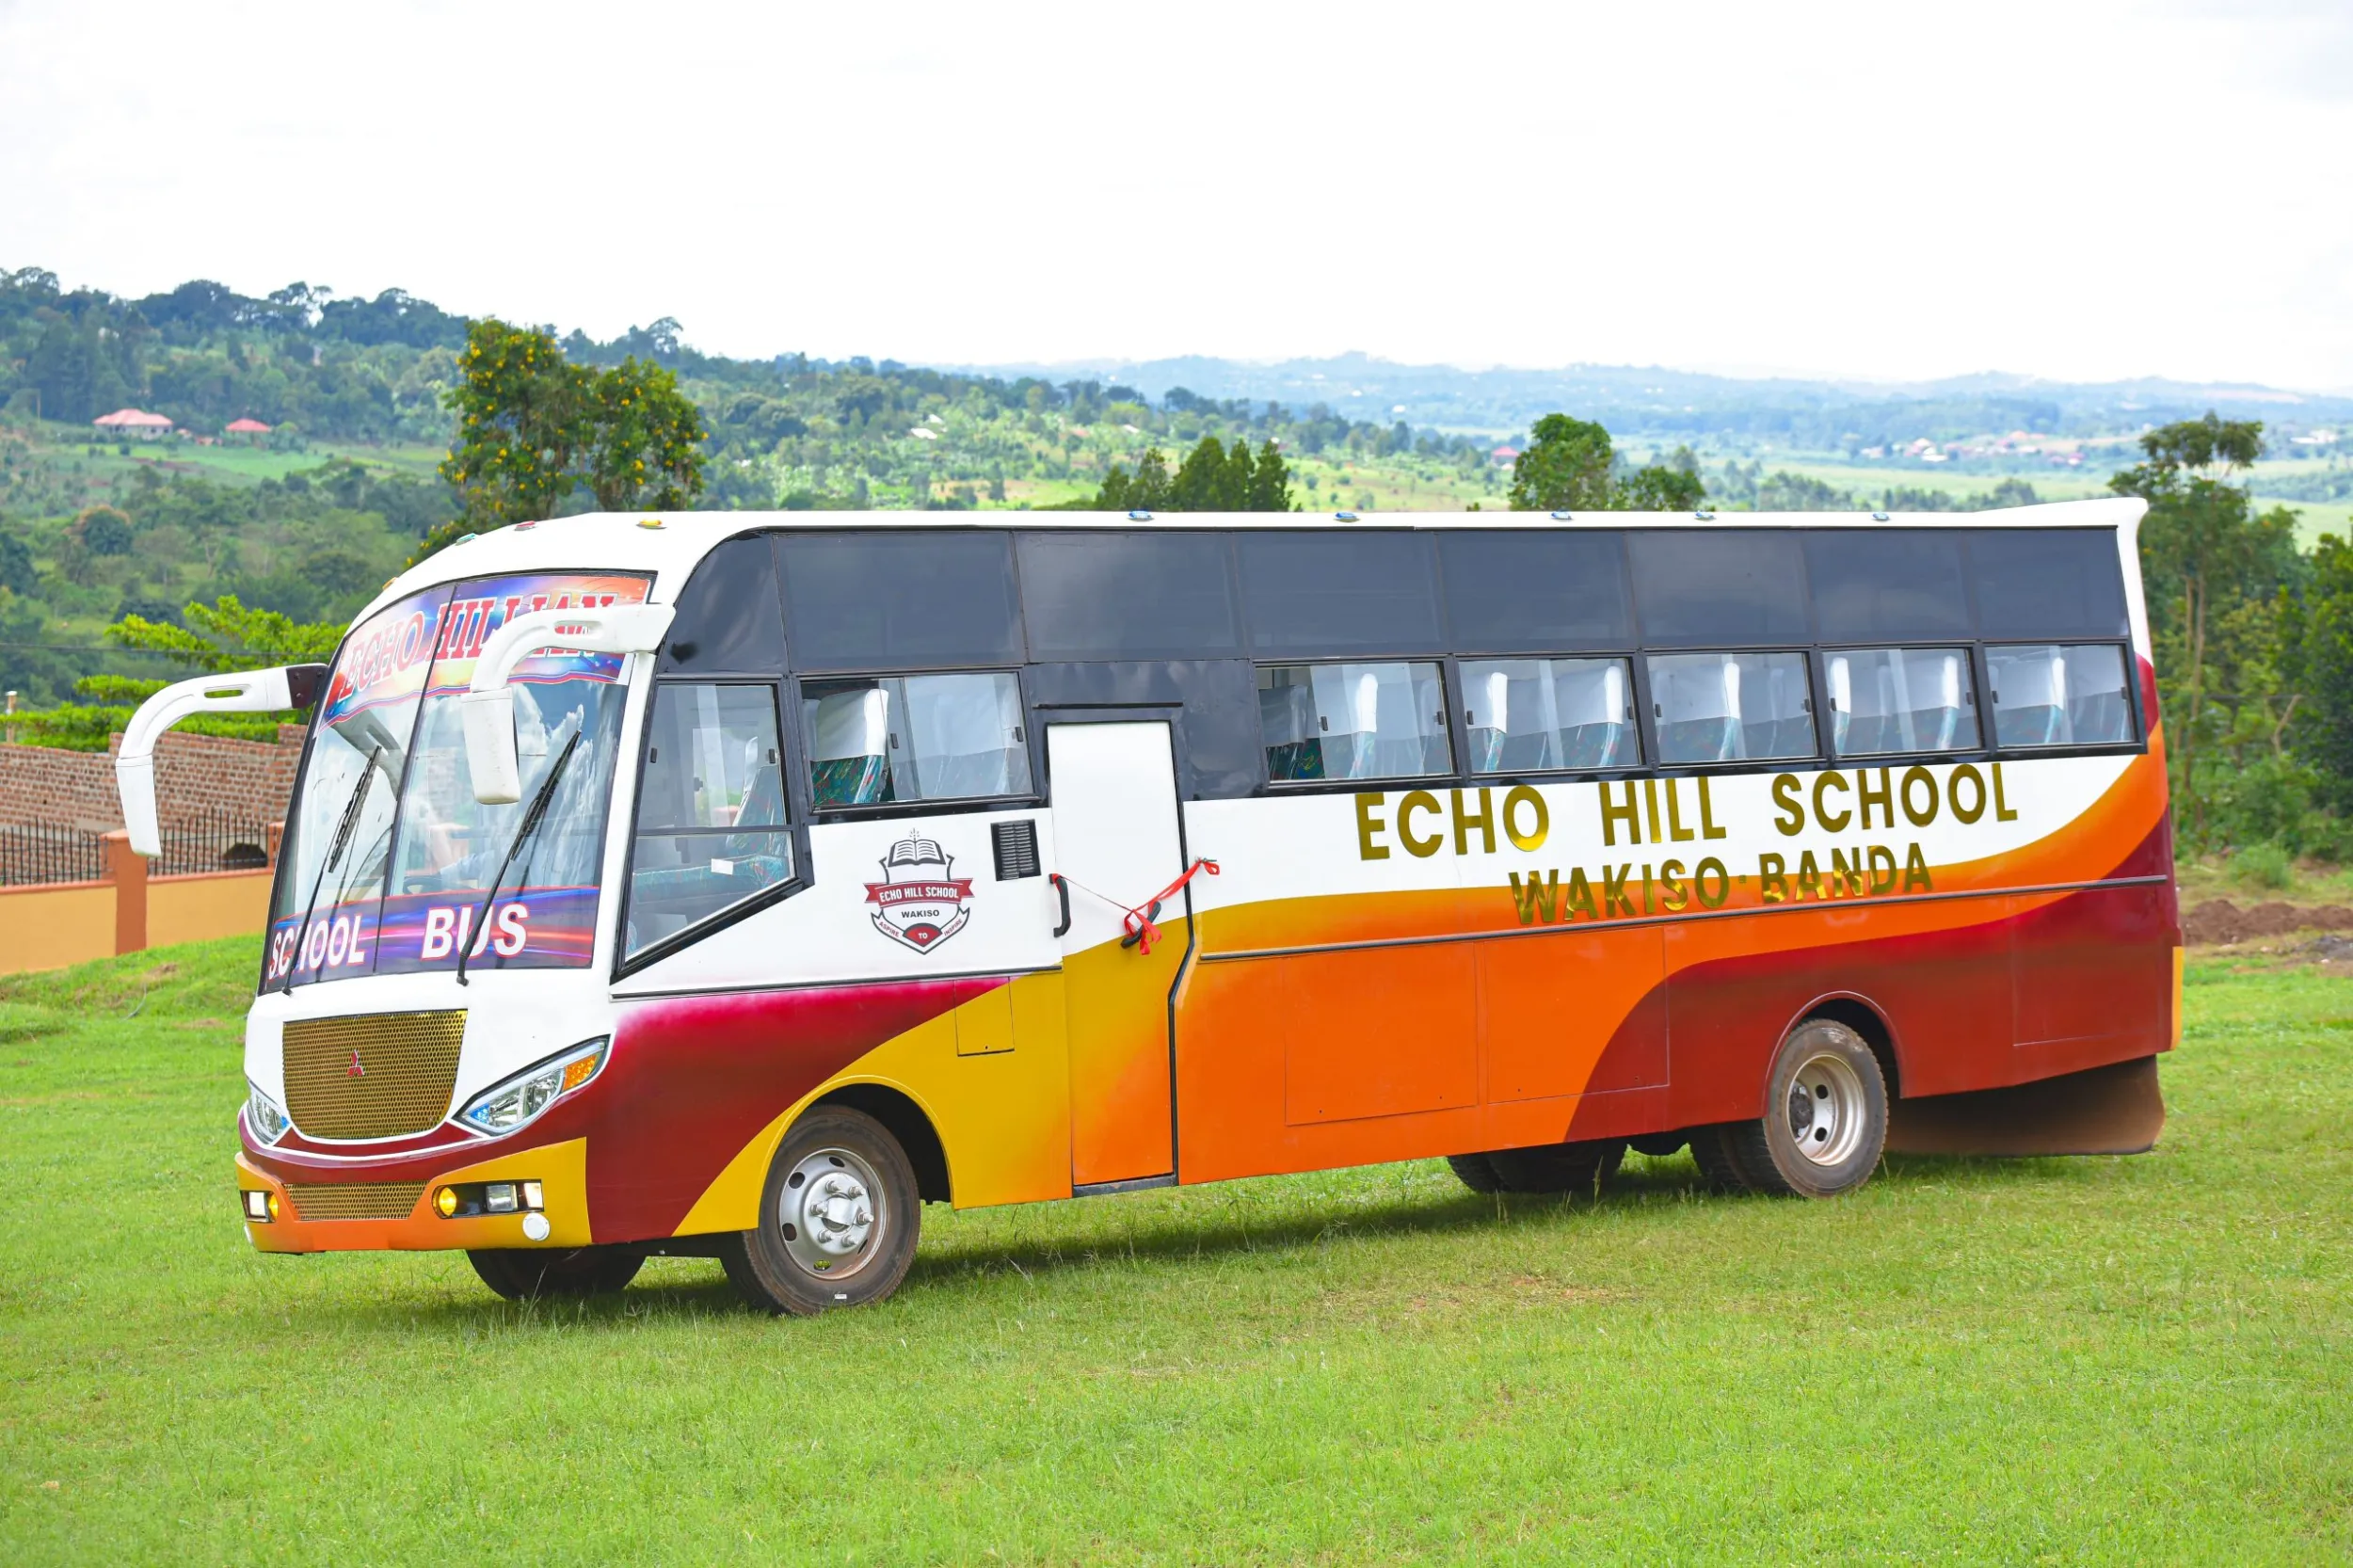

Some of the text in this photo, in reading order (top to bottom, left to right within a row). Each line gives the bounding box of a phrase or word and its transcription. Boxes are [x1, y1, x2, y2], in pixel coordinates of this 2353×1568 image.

[337, 610, 426, 701] ECHO
[1355, 762, 2018, 860] ECHO HILL SCHOOL
[879, 887, 959, 902] ECHO HILL SCHOOL
[901, 909, 939, 918] WAKISO
[267, 902, 530, 981] SCHOOL BUS
[878, 921, 899, 937] ASPIRE
[944, 918, 963, 936] INSPIRE
